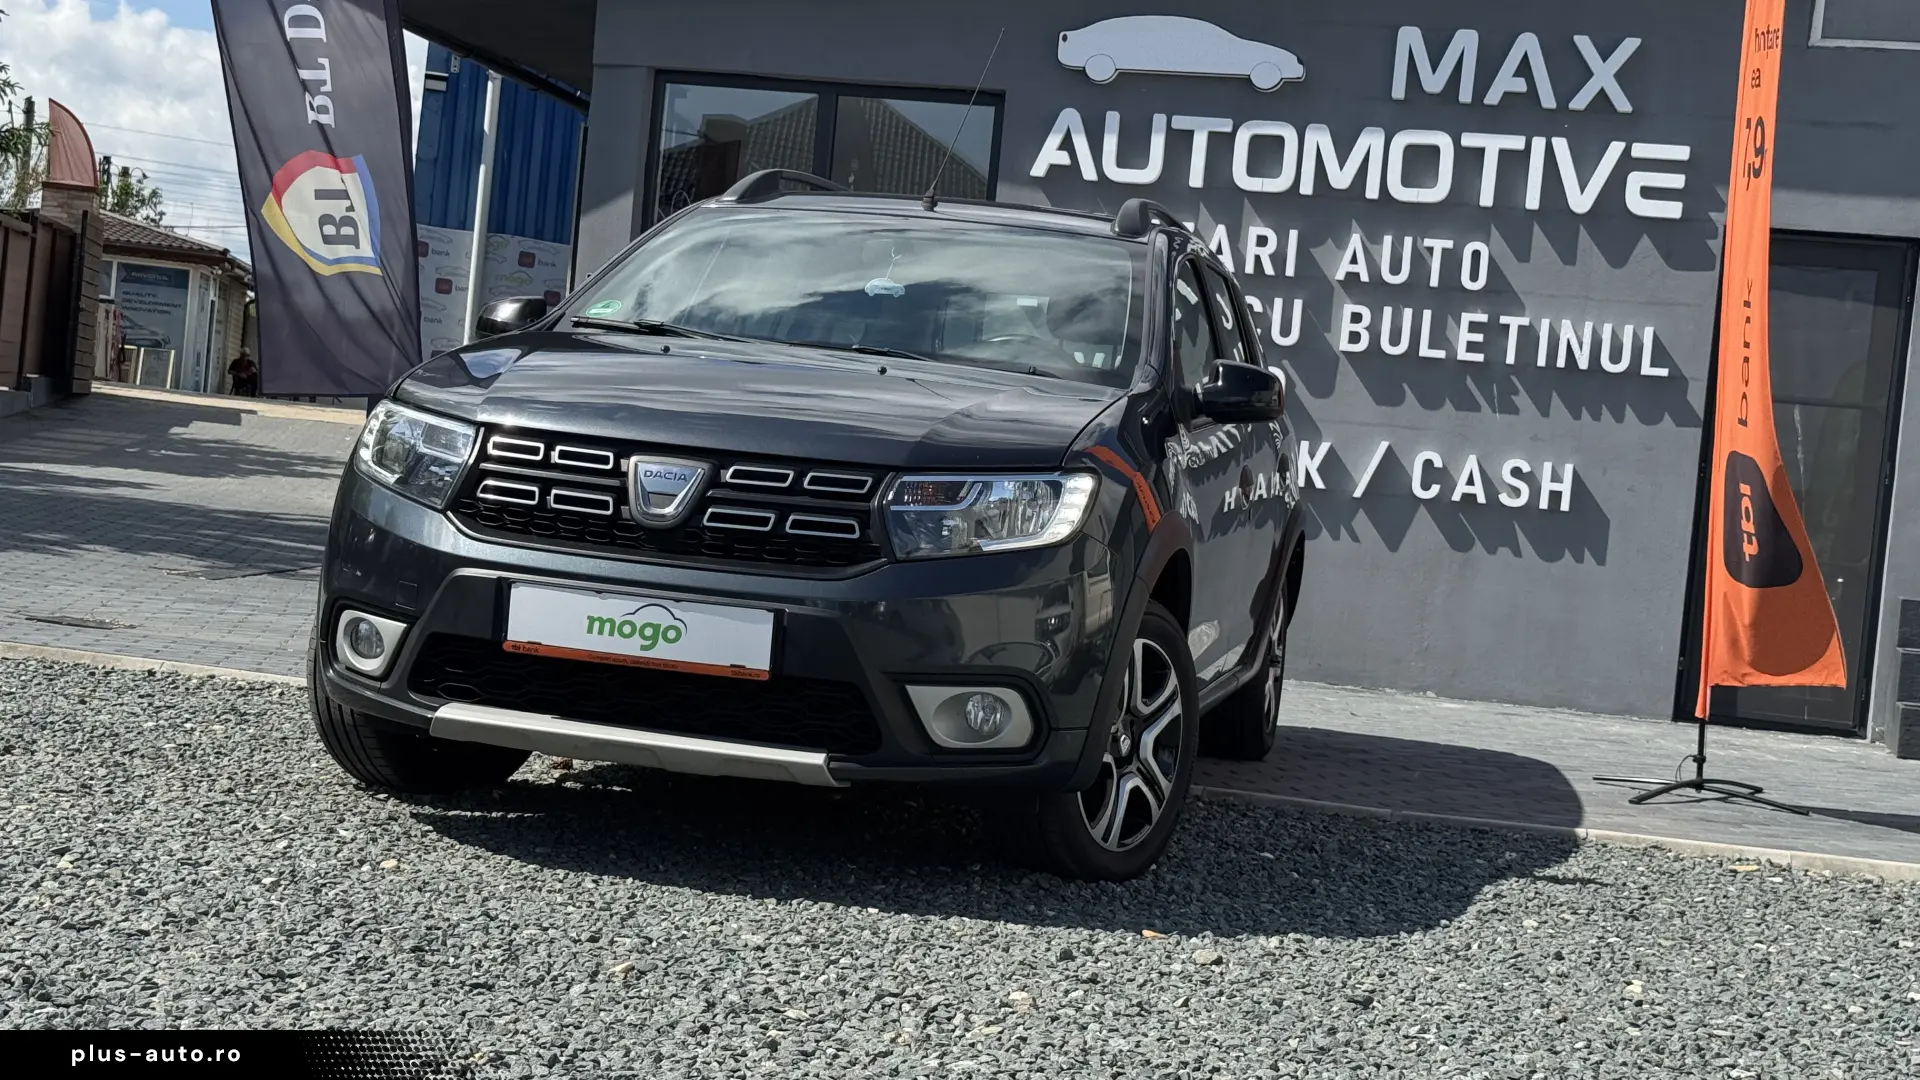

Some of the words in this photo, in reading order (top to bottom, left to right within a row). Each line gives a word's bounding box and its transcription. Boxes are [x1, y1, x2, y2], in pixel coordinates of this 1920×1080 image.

[1391, 26, 1643, 113] MAX
[1029, 107, 1691, 219] AUTOMOTIVE
[454, 283, 469, 292] ban
[1182, 222, 1299, 278] ARI
[1334, 233, 1491, 292] AUTO
[1339, 303, 1670, 377] BULETINUL
[643, 469, 688, 482] DACIA
[1352, 440, 1391, 498] /
[1411, 450, 1574, 512] CASH
[586, 614, 683, 651] mogo
